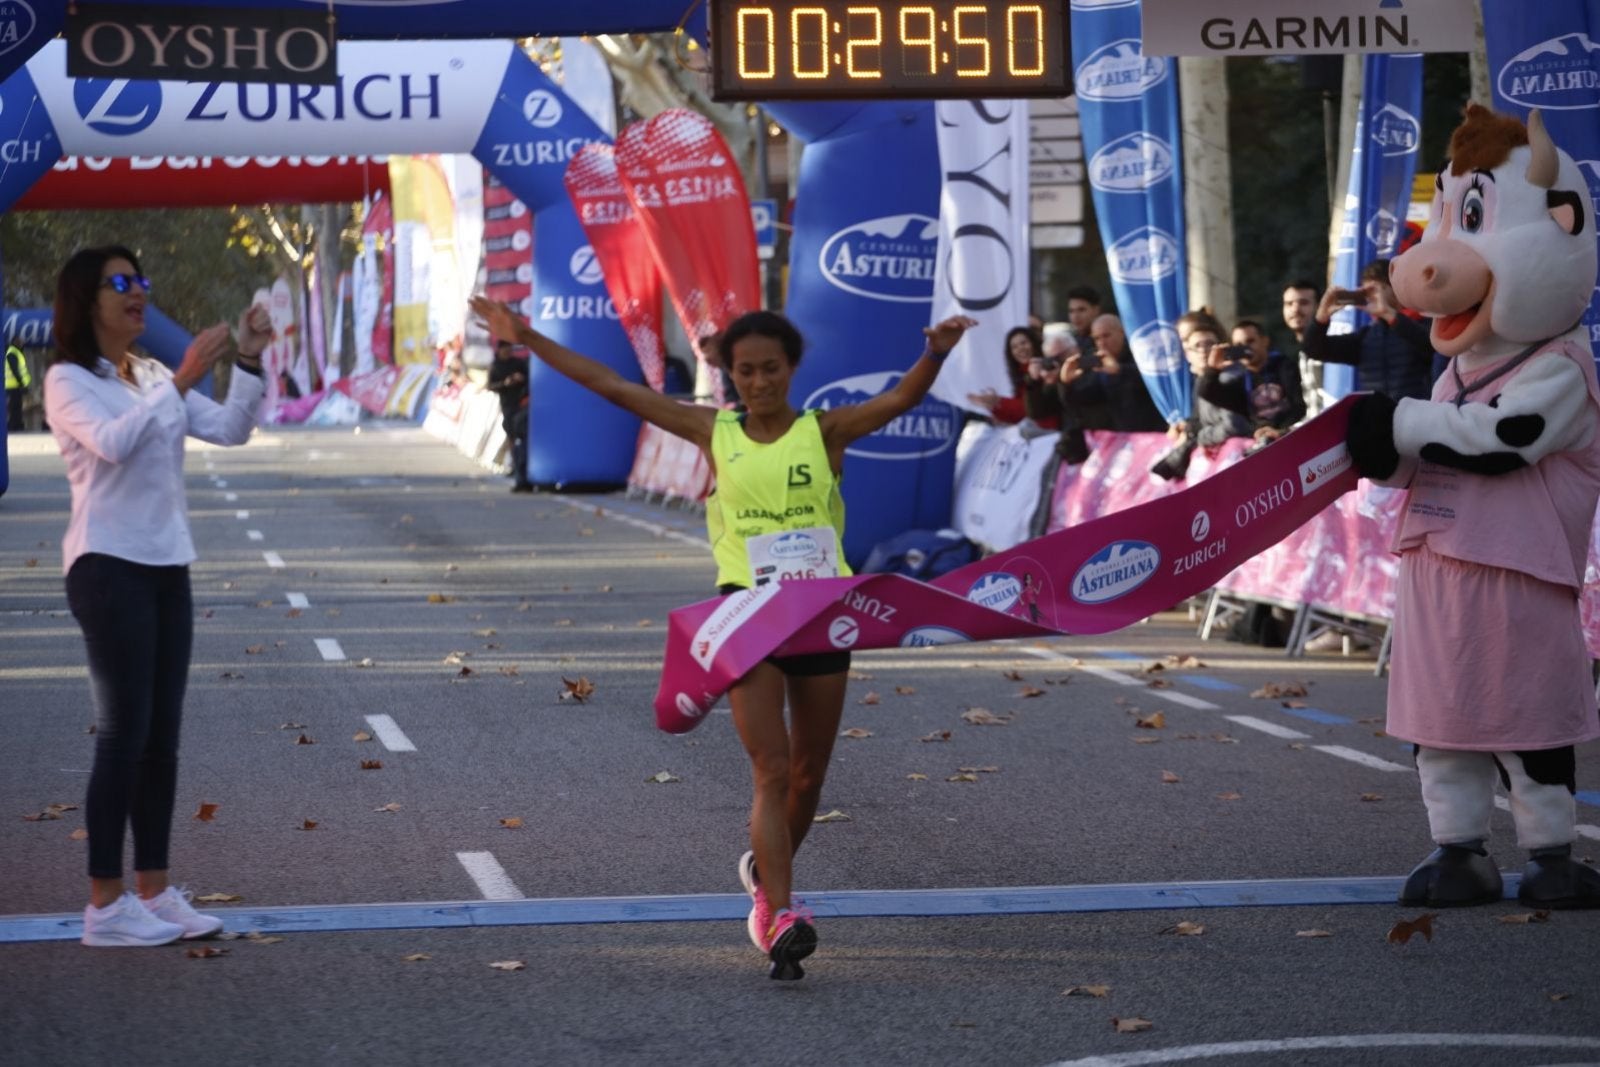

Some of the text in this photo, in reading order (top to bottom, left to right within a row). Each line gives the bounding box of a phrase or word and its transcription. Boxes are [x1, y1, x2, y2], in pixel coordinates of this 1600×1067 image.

[81, 21, 328, 72] OYSHO
[737, 5, 1044, 79] 00:29:50
[1201, 15, 1409, 50] GARMIN
[185, 74, 441, 121] ZURICH
[492, 138, 594, 167] ZURIC
[787, 463, 813, 488] LS
[1234, 477, 1295, 528] OYSHO
[1078, 557, 1154, 597] ASTURIANA
[1173, 538, 1227, 576] ZURICH
[707, 582, 769, 641] Santander
